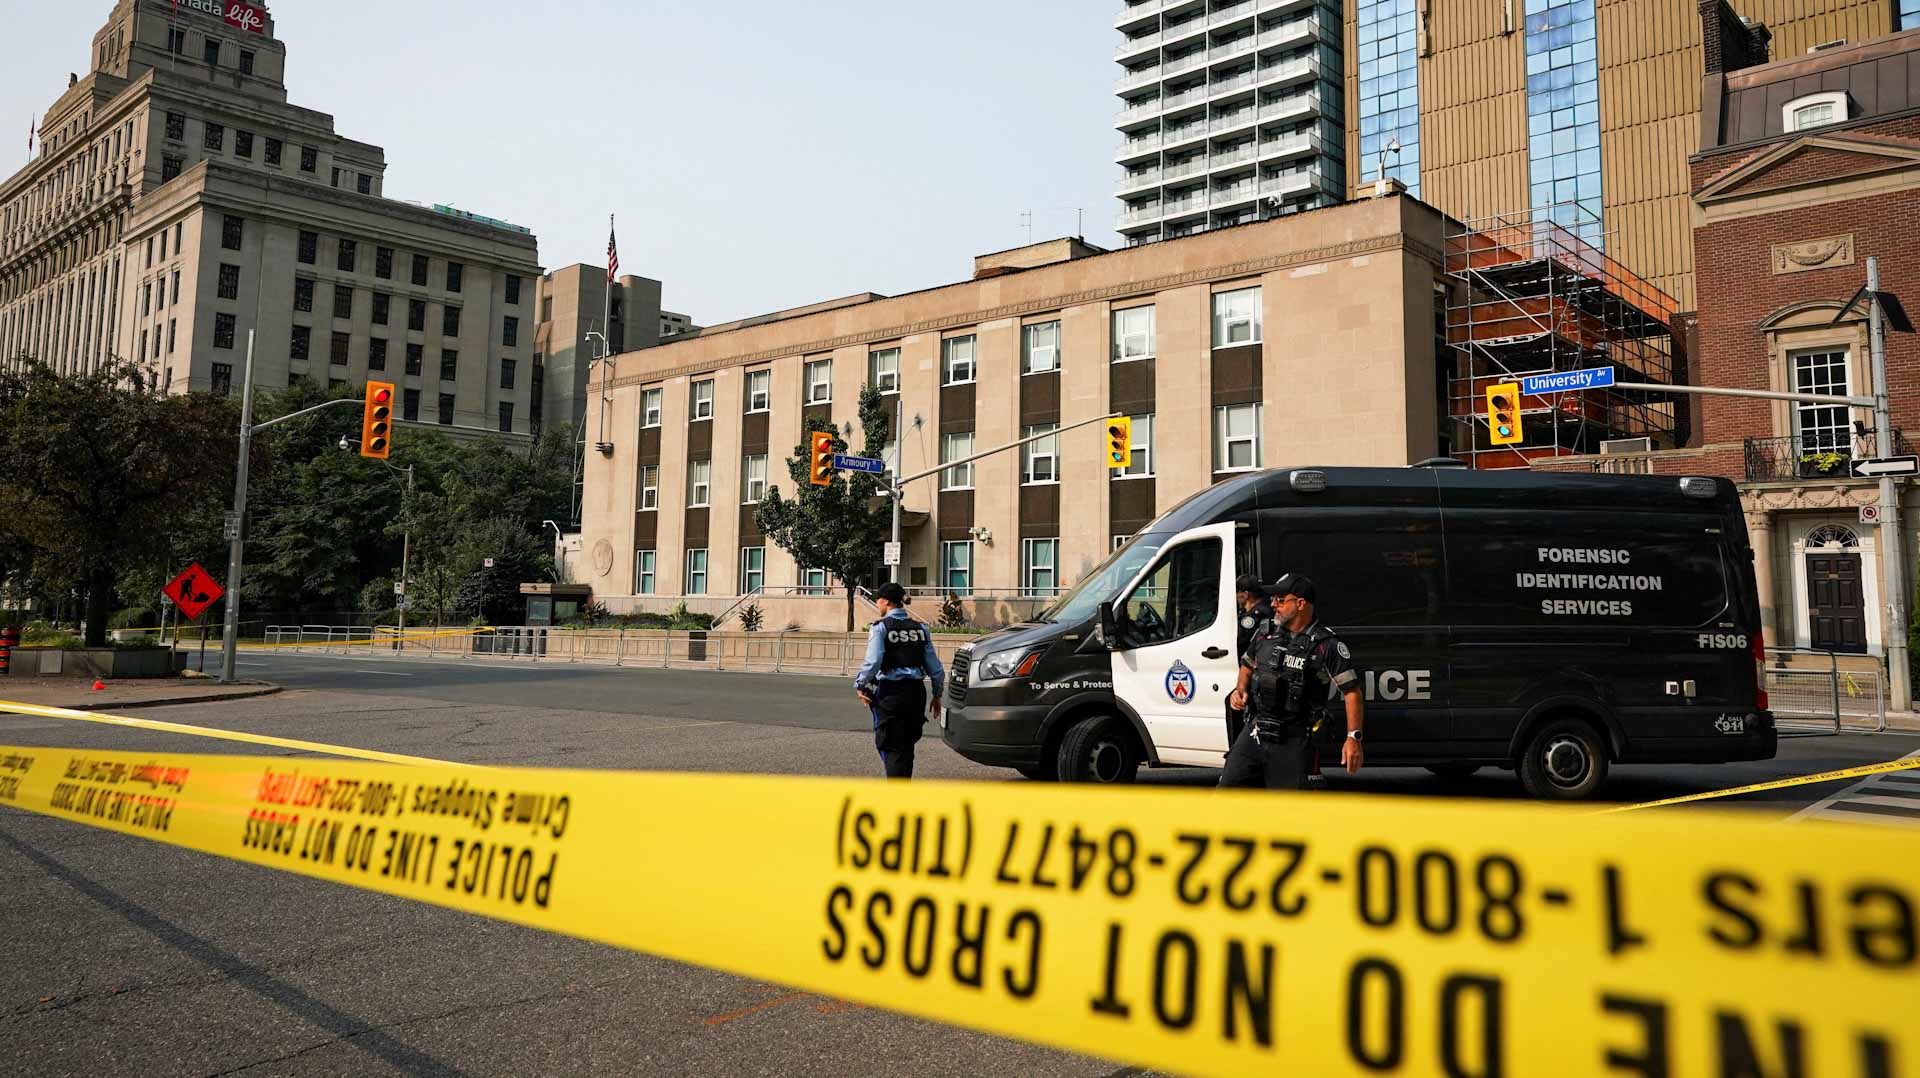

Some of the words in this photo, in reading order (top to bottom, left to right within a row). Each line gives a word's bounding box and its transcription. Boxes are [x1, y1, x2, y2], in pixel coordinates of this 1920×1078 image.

[177, 0, 222, 16] nada
[225, 5, 264, 30] life
[1529, 372, 1593, 390] University
[840, 457, 871, 471] Armoury
[1538, 547, 1631, 564] FORENSIC
[1516, 572, 1663, 591] IDENTIFICATION
[1541, 599, 1633, 616] SERVICES
[1282, 654, 1306, 670] POLICE
[1698, 633, 1748, 649] FIS06
[1030, 682, 1041, 690] To
[1044, 681, 1070, 690] Serve
[1073, 681, 1080, 689] &
[1082, 680, 1113, 689] Protec
[412, 779, 498, 831] Stoppers
[502, 792, 570, 839] Crime
[242, 808, 299, 856] CROSS
[301, 817, 343, 866] NOT
[345, 823, 377, 872] DO
[836, 795, 974, 880] (TIPS)
[381, 828, 440, 886] LINE
[446, 838, 558, 908] POLICE
[820, 884, 1044, 1001] CROSS
[1091, 922, 1276, 1049] NOT
[1344, 956, 1506, 1078] DO
